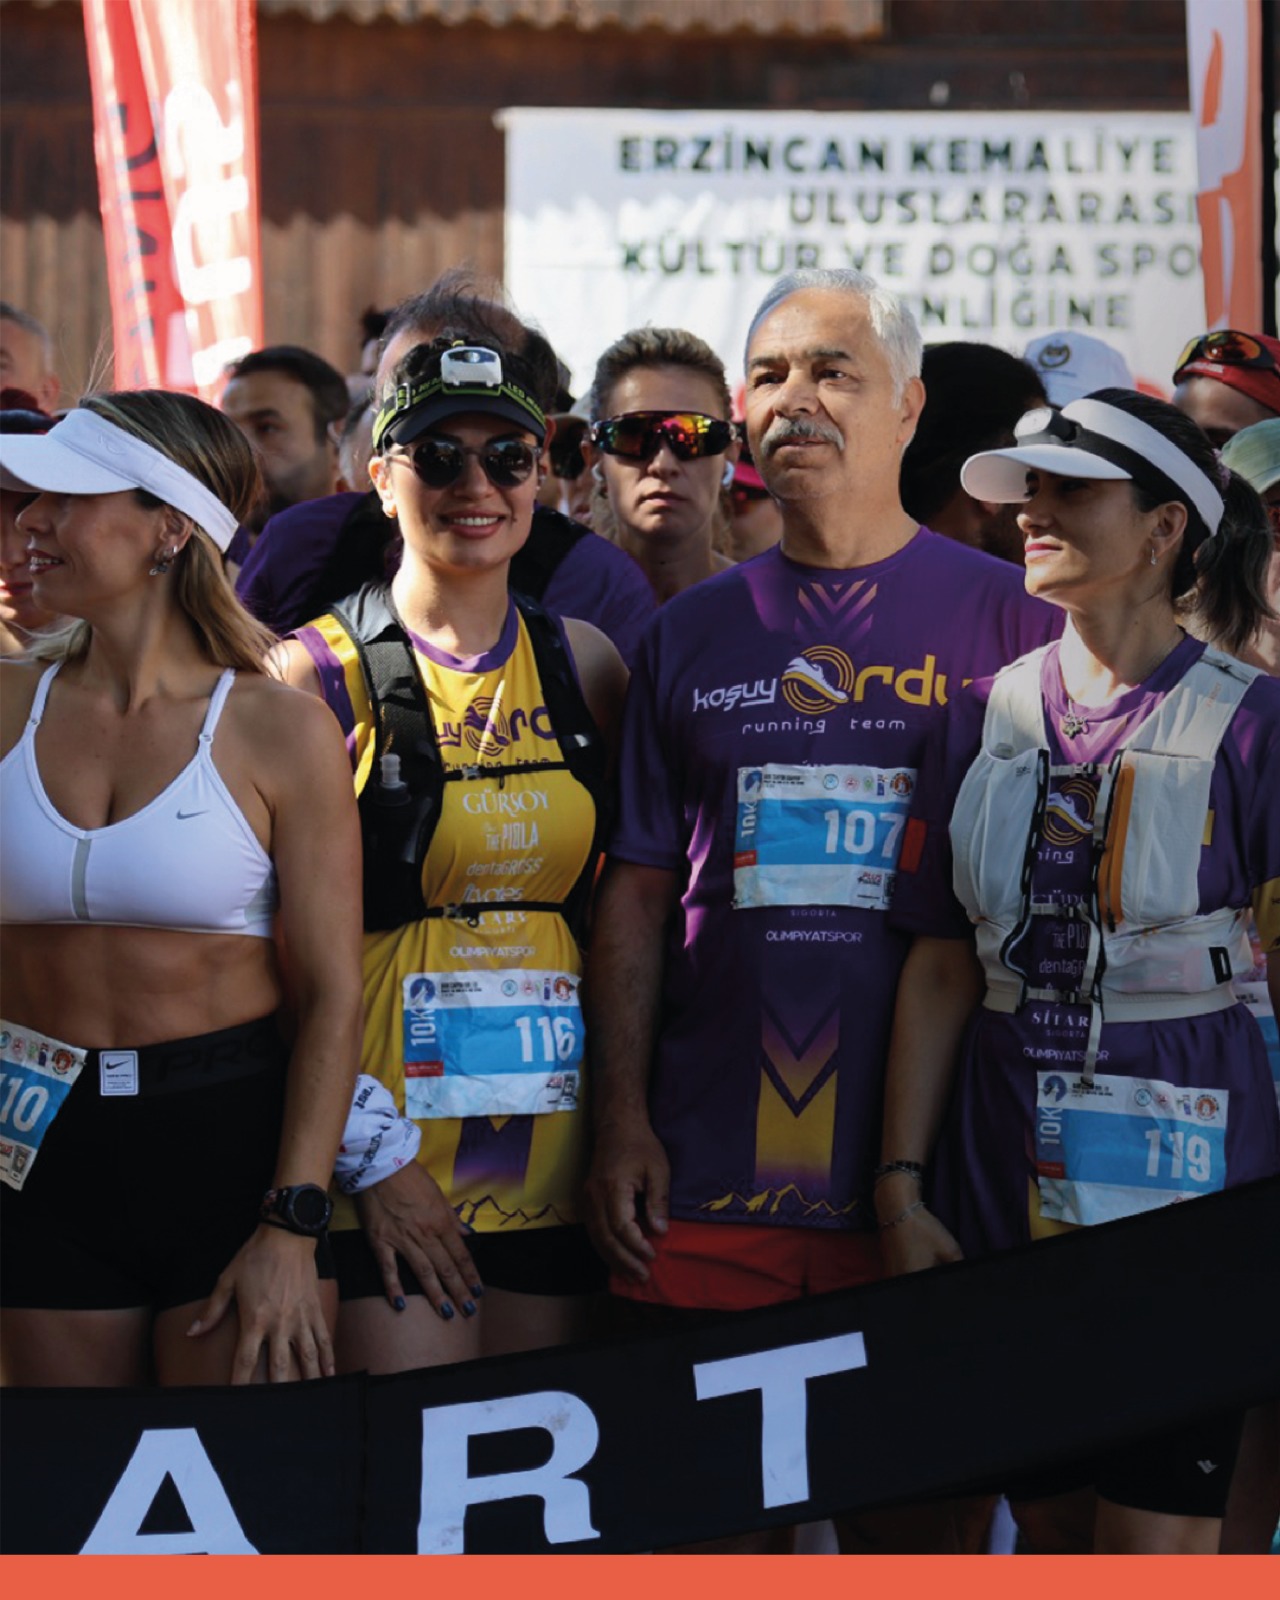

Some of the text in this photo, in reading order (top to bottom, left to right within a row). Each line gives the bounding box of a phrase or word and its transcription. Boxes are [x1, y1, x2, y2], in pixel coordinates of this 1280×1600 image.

[619, 127, 1176, 173] ERZİNCAN KEMALİYE
[790, 190, 1196, 225] ULUSLARARASI
[620, 229, 822, 274] KÜLTÜR
[846, 242, 905, 275] VE
[929, 228, 1072, 276] DOĞA
[742, 717, 905, 735] running team
[462, 788, 550, 818] GÜRSOY
[824, 810, 906, 858] 107
[515, 1015, 576, 1063] 116
[0, 1073, 49, 1132] 10
[1145, 1129, 1211, 1182] 119
